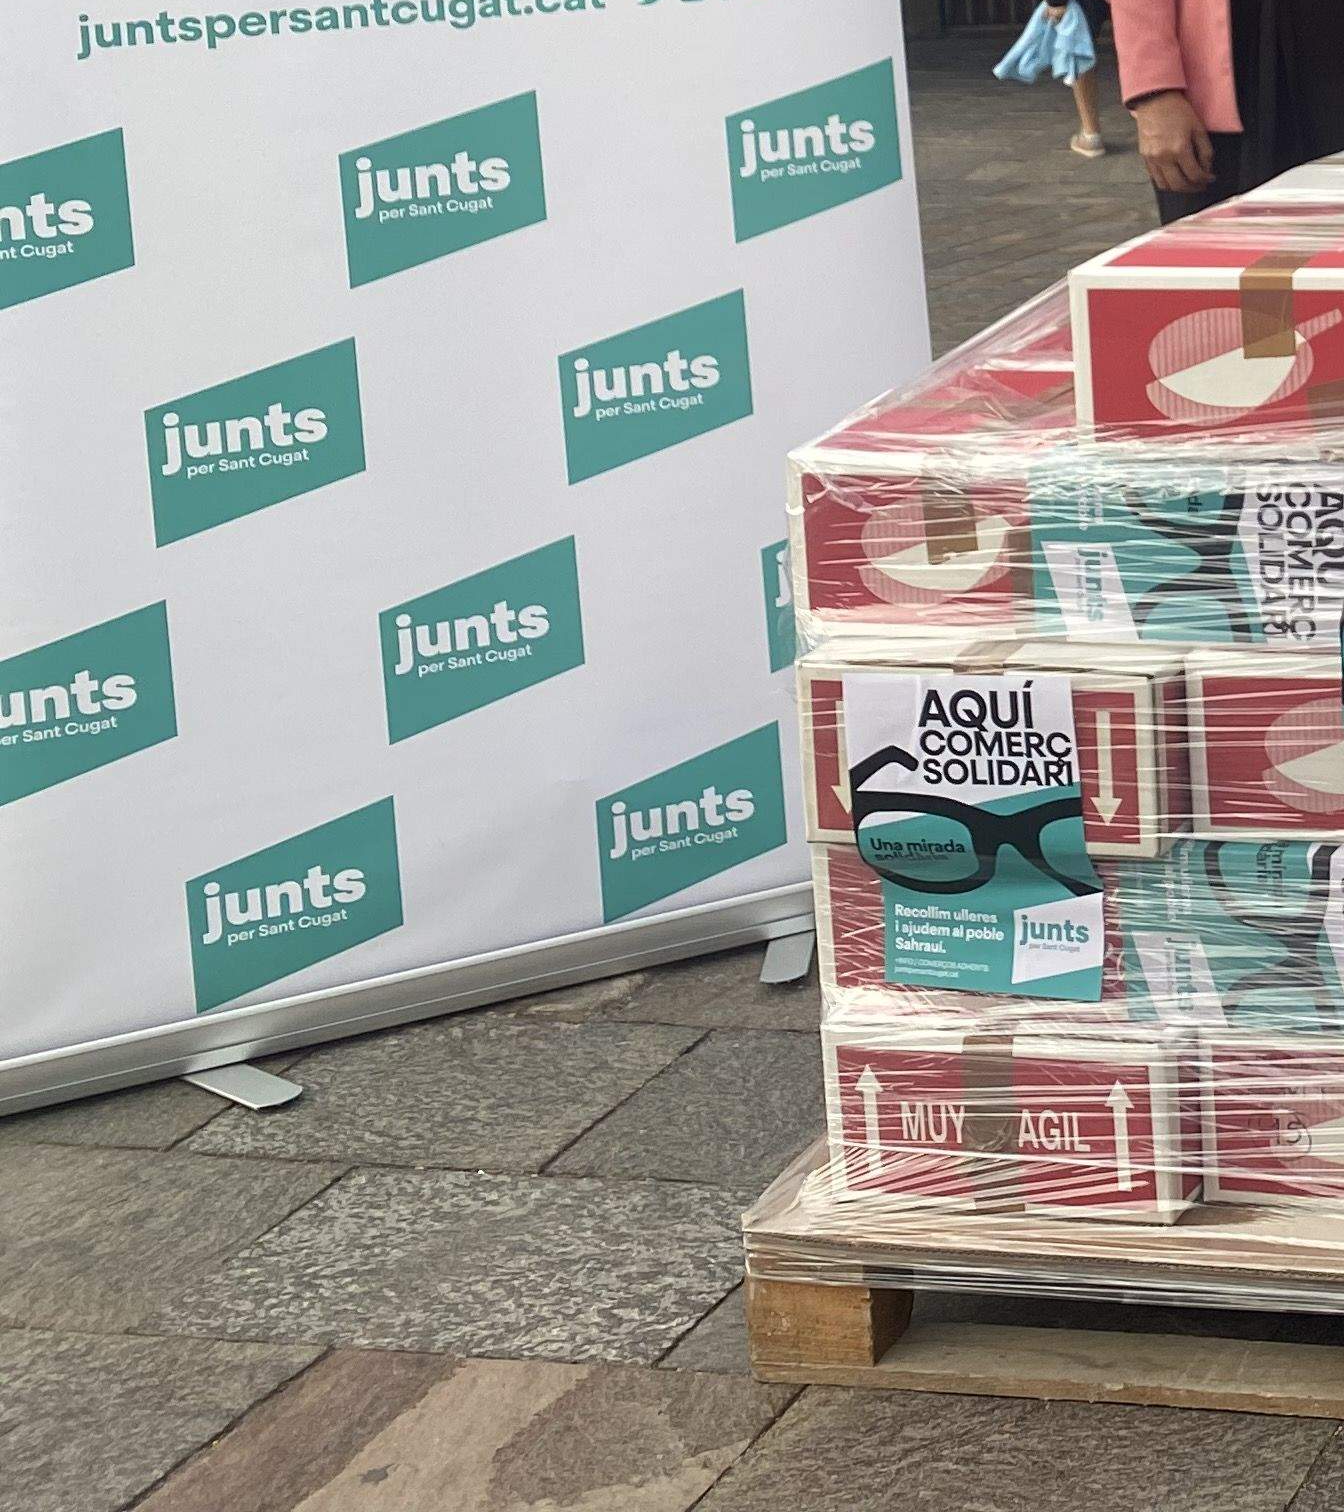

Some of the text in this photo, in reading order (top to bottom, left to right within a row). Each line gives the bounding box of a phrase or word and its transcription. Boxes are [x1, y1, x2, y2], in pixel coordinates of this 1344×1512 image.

[740, 114, 875, 177] junts
[355, 151, 510, 218] junts
[761, 157, 861, 182] per Sant Cugat
[379, 197, 494, 224] per Sant Cugat
[573, 350, 720, 418] junts
[595, 394, 704, 421] per Sant Cugat
[162, 403, 328, 476] junts
[187, 448, 309, 479] per Sant Cugat
[395, 600, 550, 675] junts
[418, 644, 532, 677] per Sant Cugat
[0, 670, 137, 728] unts
[919, 680, 1033, 732] AQUÍ
[22, 716, 118, 742] Sant Cugat
[920, 729, 1071, 769] COMERÇ
[923, 759, 1073, 786] SOLIDARI
[610, 786, 754, 859] junts
[632, 827, 738, 860] per Sant Cugat
[870, 838, 965, 854] Una mirada
[203, 866, 366, 944] junts
[895, 904, 998, 923] Recollim ulleres
[228, 909, 348, 946] per Sant Cugat
[901, 921, 949, 938] ajudem
[952, 925, 964, 938] al
[966, 925, 1004, 942] poble
[1019, 914, 1089, 946] junts
[901, 1101, 1091, 1152] MUY AGIL
